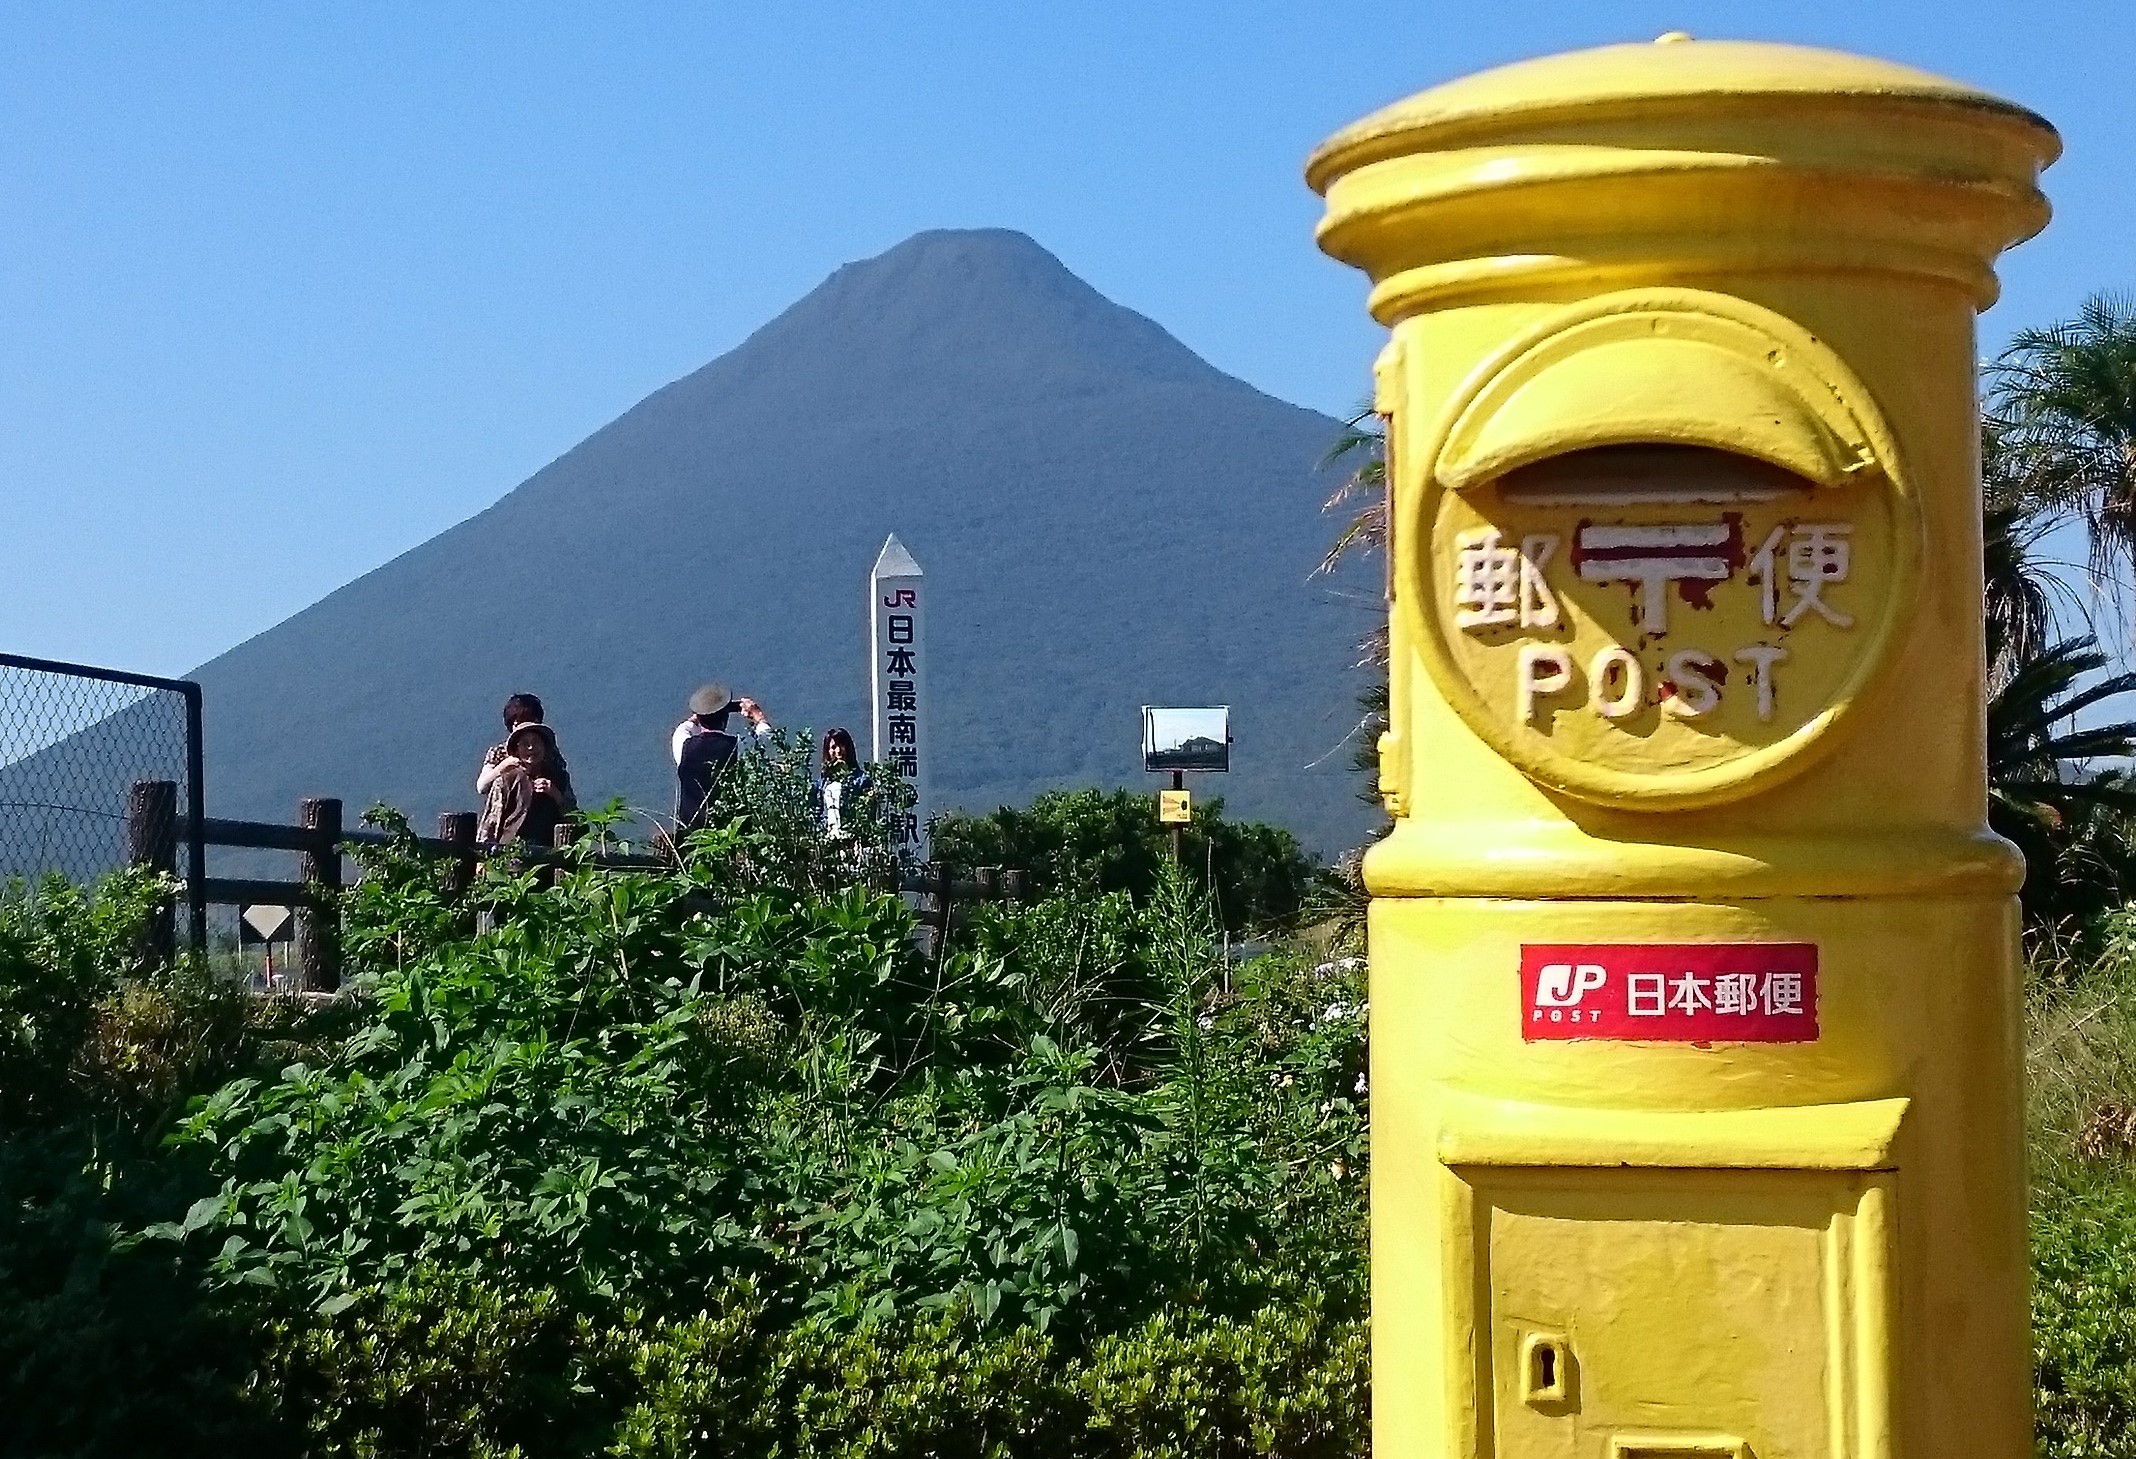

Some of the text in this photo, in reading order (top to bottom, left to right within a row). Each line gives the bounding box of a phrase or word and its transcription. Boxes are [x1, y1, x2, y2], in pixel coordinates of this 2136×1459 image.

[883, 588, 917, 609] JR
[1516, 643, 1789, 723] POST
[1534, 964, 1608, 1007] JP
[1627, 971, 1804, 1016] 日本郵便
[1532, 1009, 1602, 1023] POST
